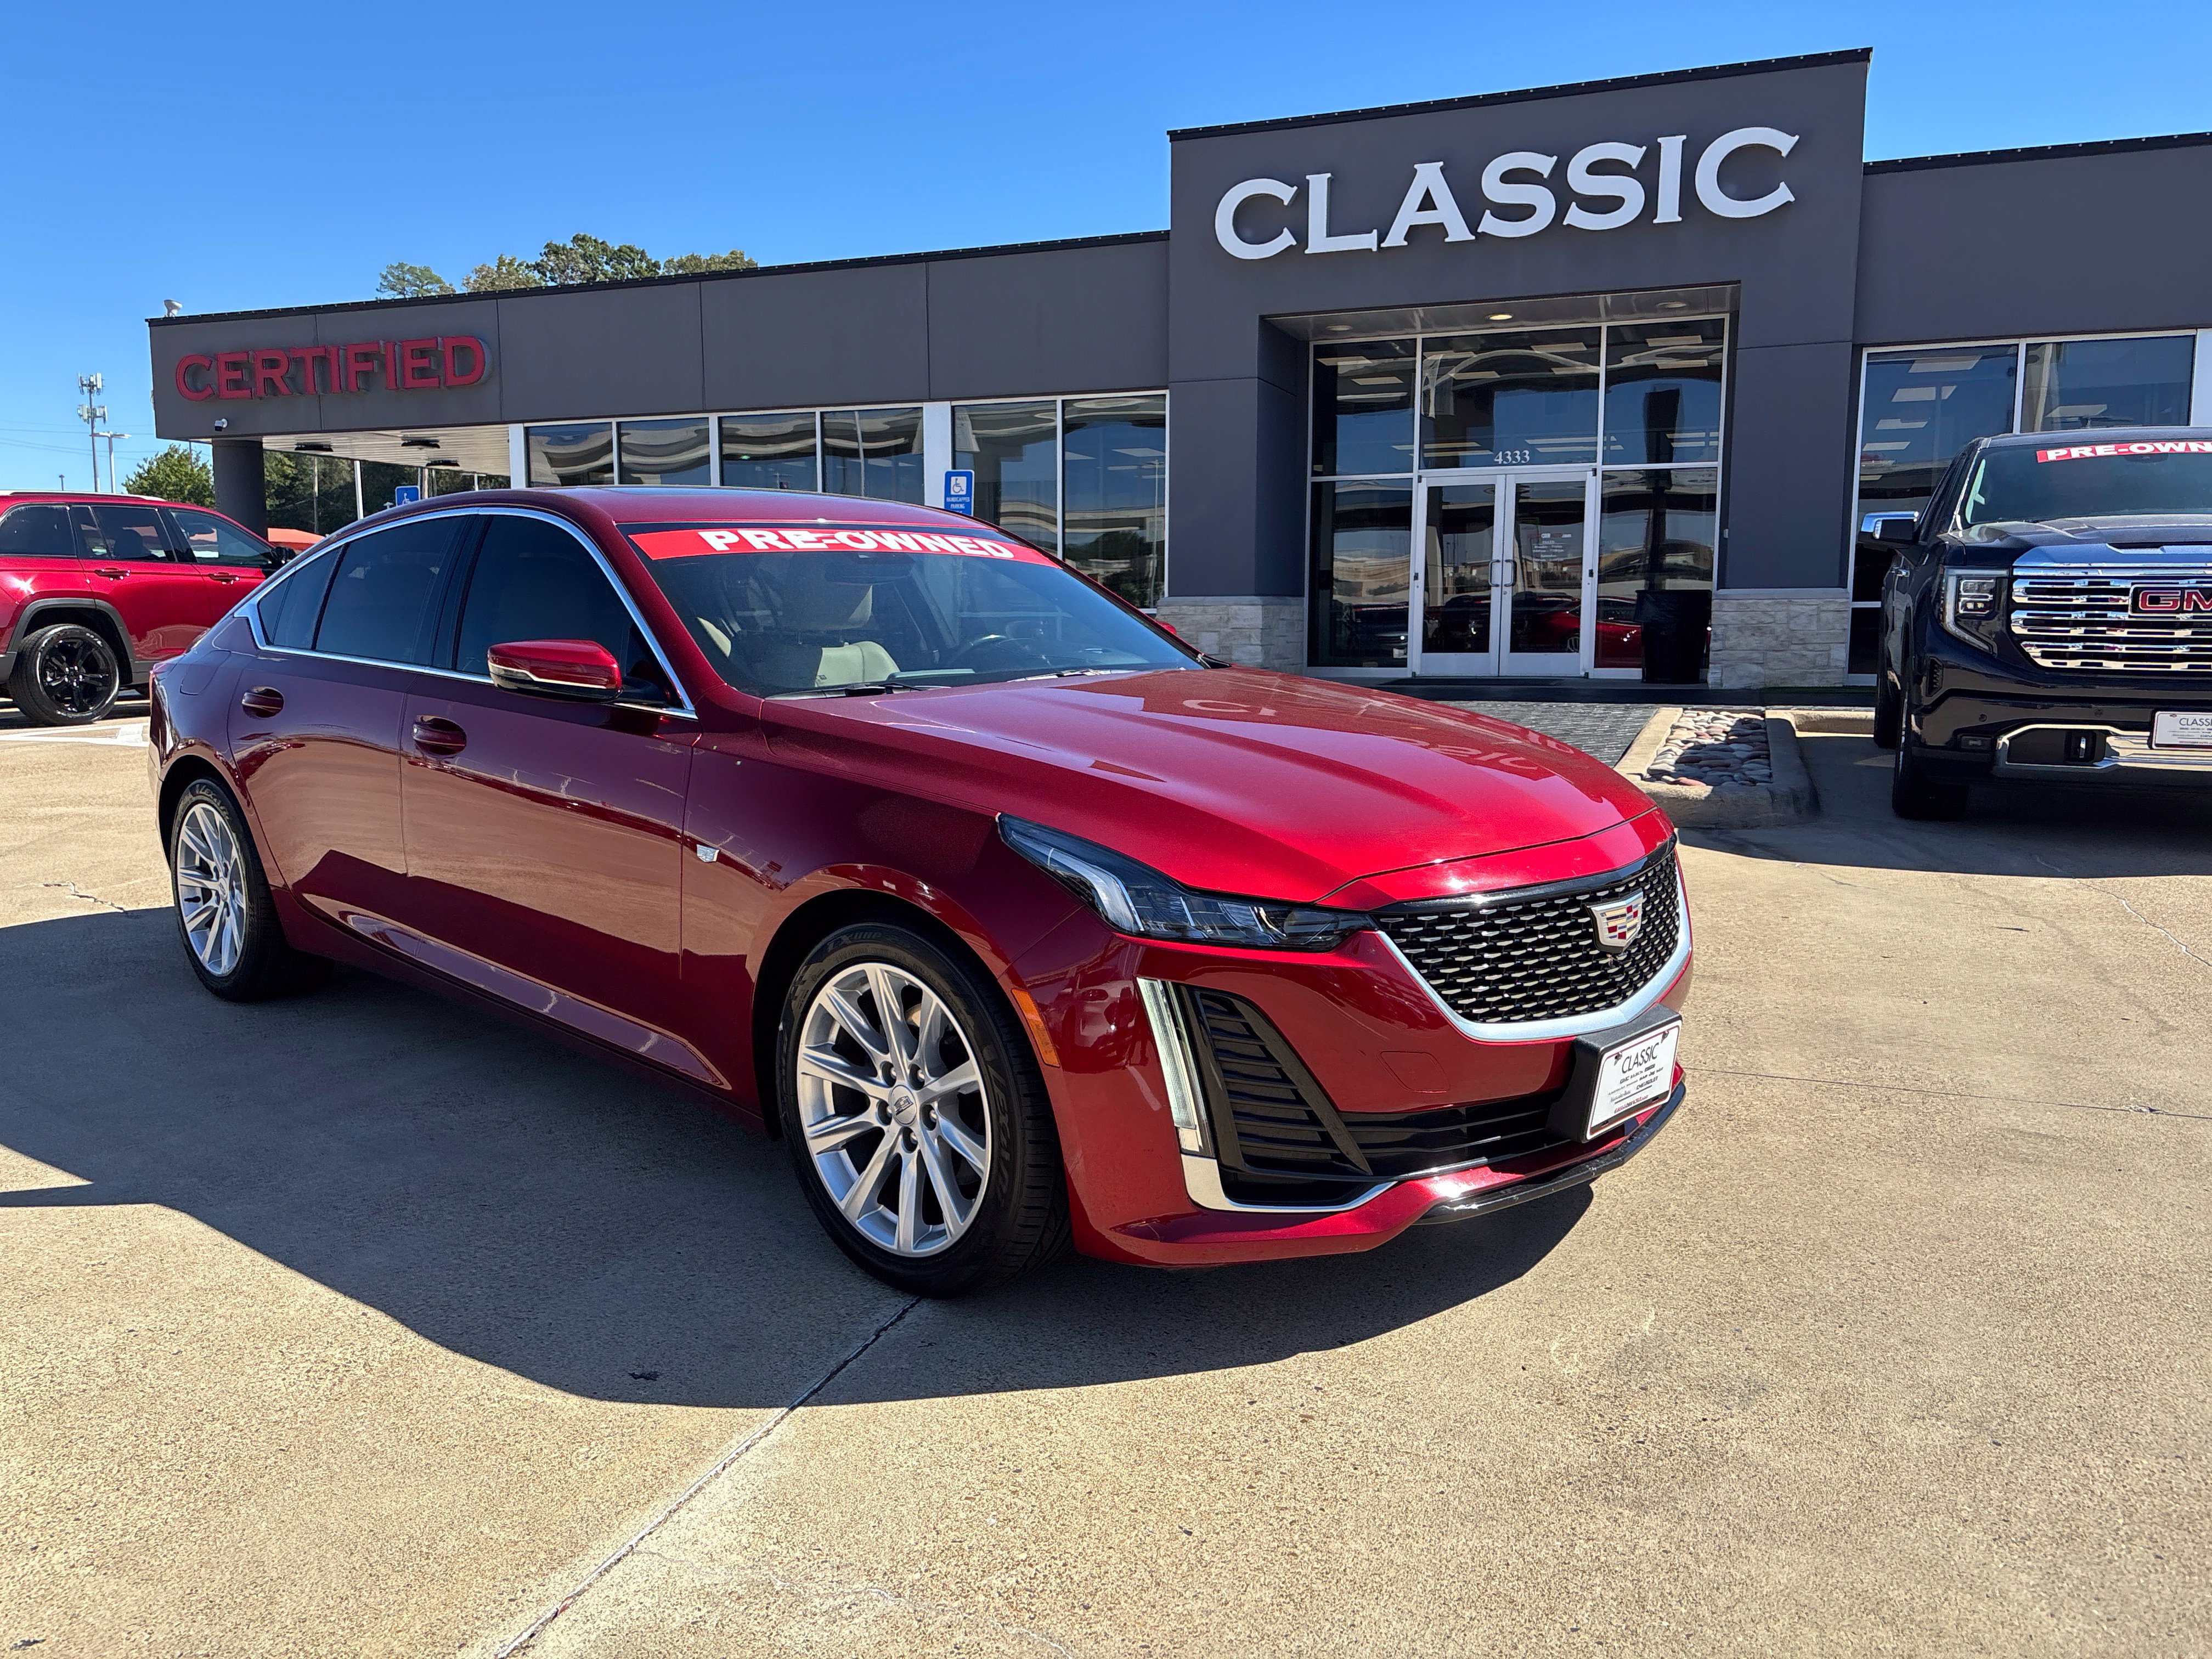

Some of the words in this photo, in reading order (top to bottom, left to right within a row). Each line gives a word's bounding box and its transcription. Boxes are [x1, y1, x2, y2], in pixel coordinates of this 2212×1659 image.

[1215, 126, 1799, 259] CLASSIC
[176, 336, 489, 401] CERTIFIED
[1494, 450, 1530, 464] 4333
[698, 529, 1014, 558] PRE-OWNED
[1622, 1042, 1660, 1074] CLASSIC
